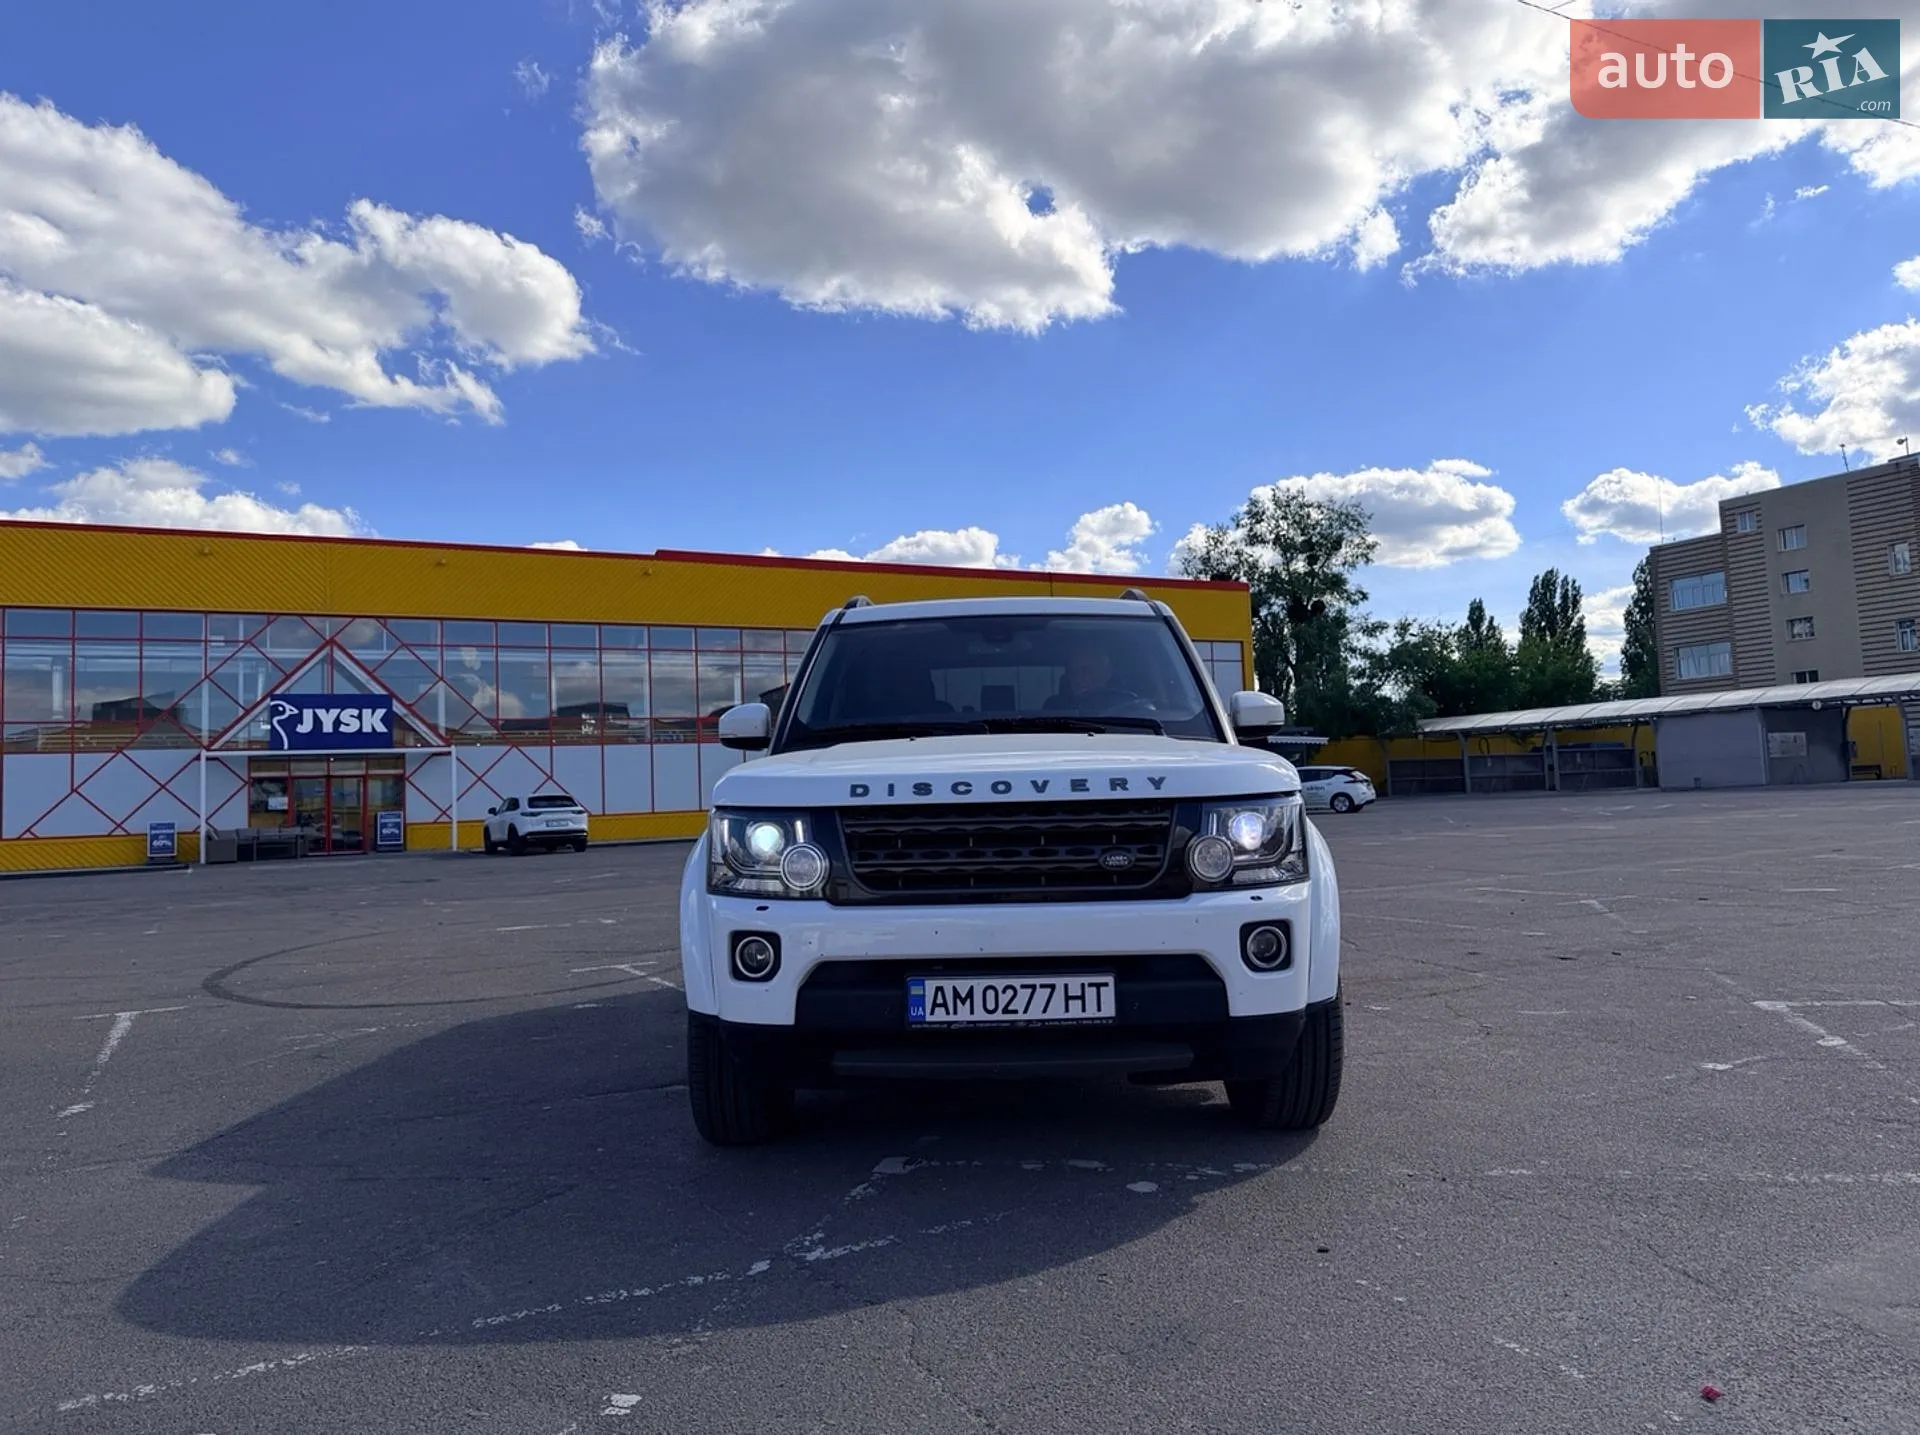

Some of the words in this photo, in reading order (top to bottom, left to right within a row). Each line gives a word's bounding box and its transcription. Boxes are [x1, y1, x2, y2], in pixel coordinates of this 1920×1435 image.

[296, 708, 388, 733] JYSK
[850, 776, 1167, 798] DISCOVERY
[910, 1007, 924, 1017] UA
